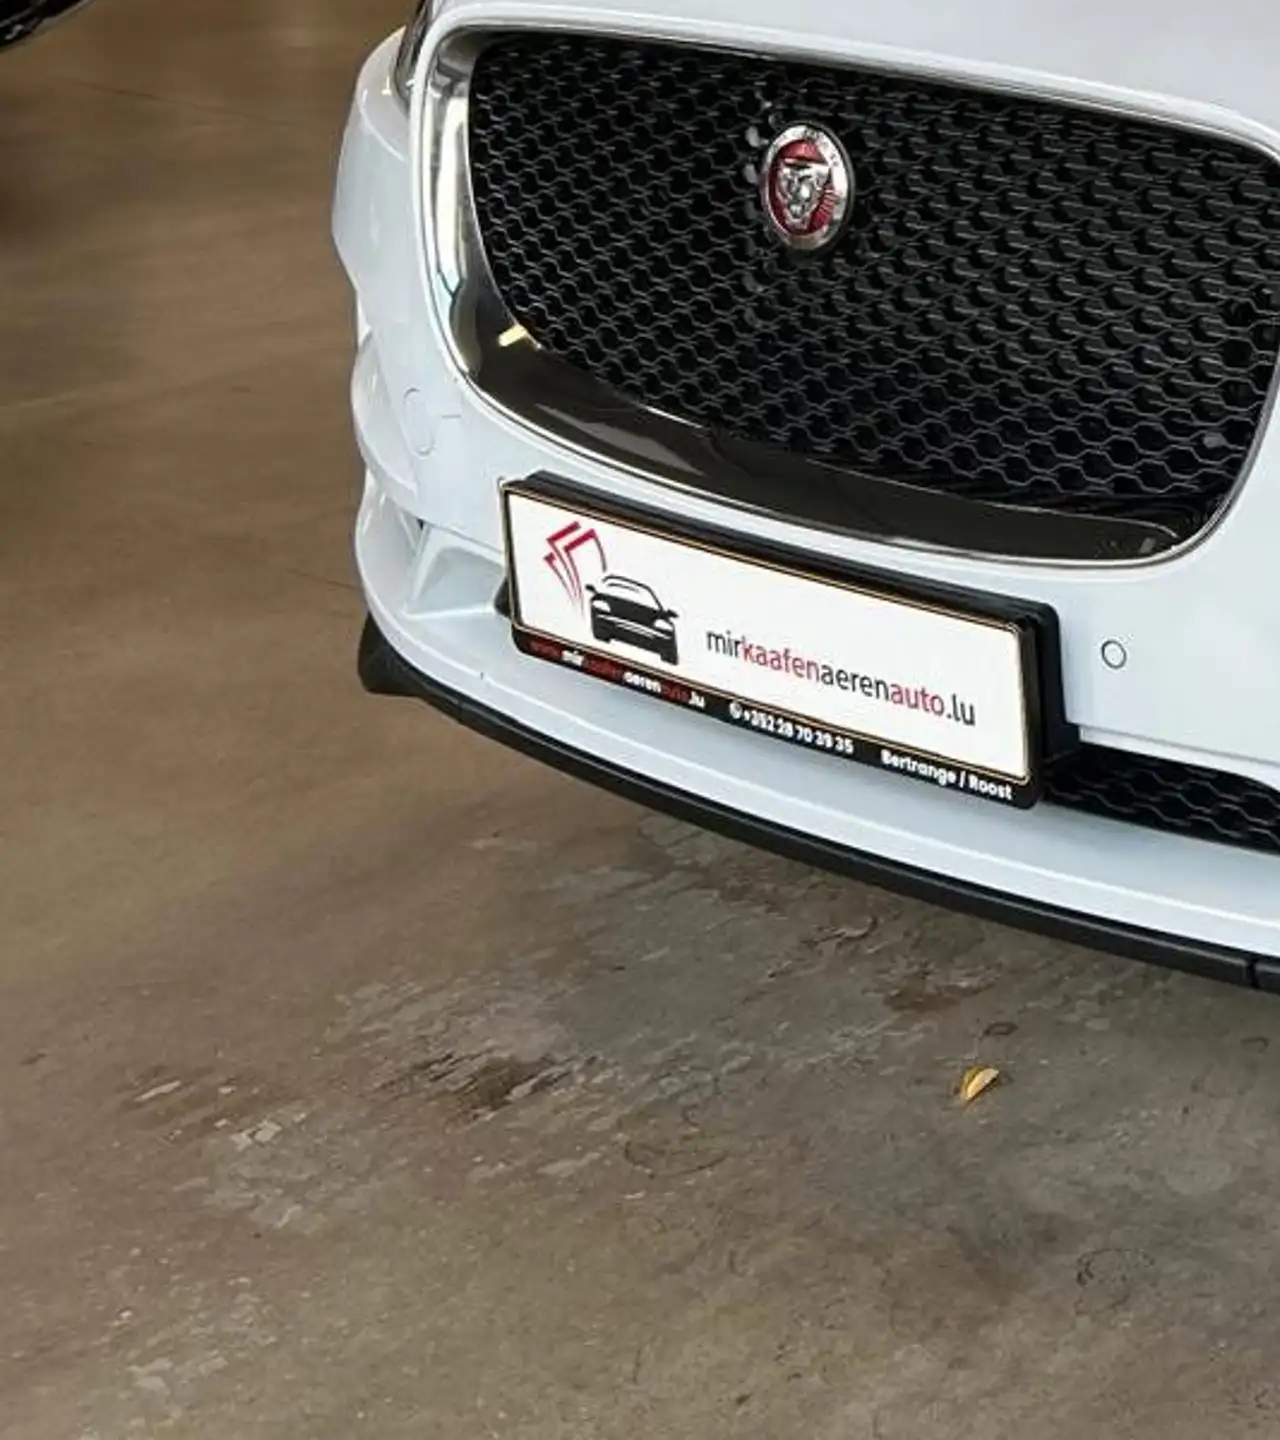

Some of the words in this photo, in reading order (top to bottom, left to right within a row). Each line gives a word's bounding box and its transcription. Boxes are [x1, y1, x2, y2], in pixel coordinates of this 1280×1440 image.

[706, 630, 976, 727] mirkaafenaerenauto.lu
[880, 749, 956, 787] Bertrange
[968, 774, 1013, 801] Roost
